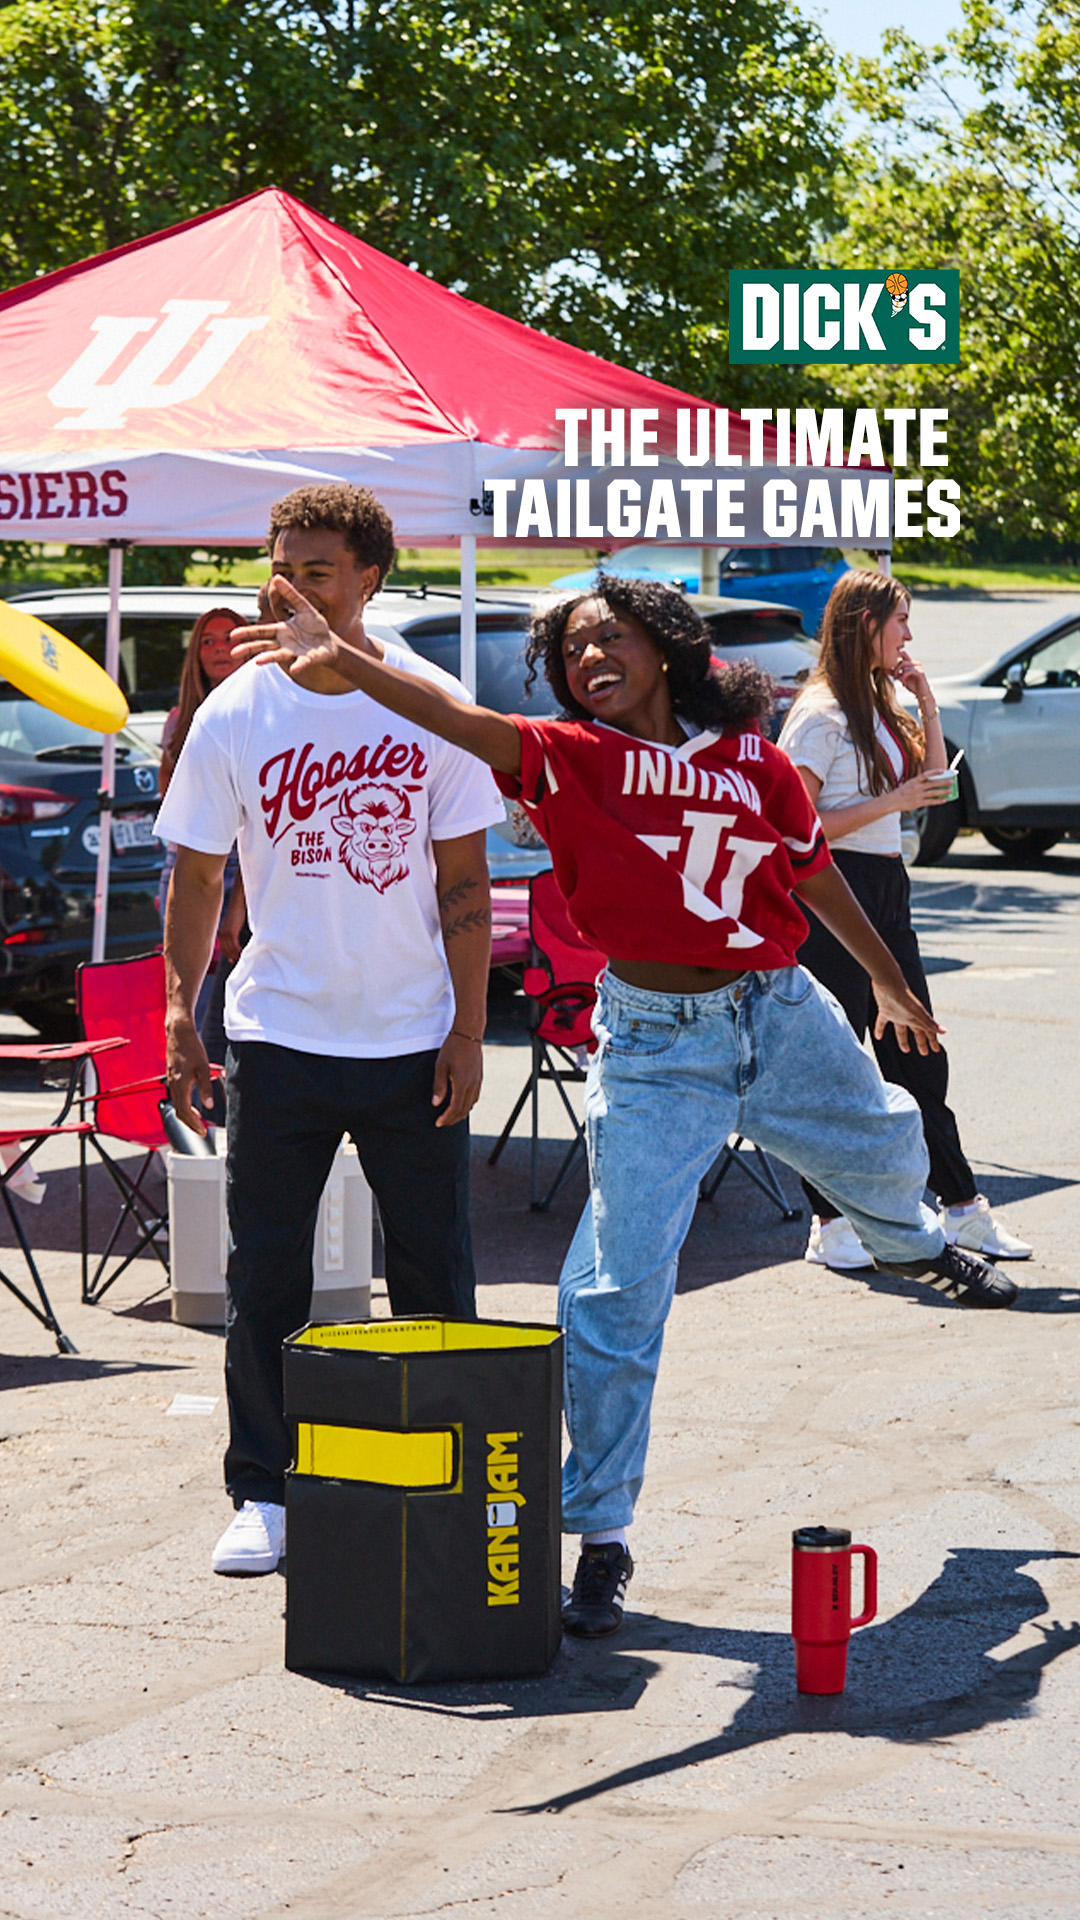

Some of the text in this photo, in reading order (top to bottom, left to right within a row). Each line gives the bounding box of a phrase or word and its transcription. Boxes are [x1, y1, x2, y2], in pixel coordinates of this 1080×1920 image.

[0, 469, 128, 520] SIERS
[258, 734, 428, 839] Hoosier
[621, 750, 762, 816] INDIANA
[291, 847, 332, 866] BISON
[295, 831, 325, 847] THE
